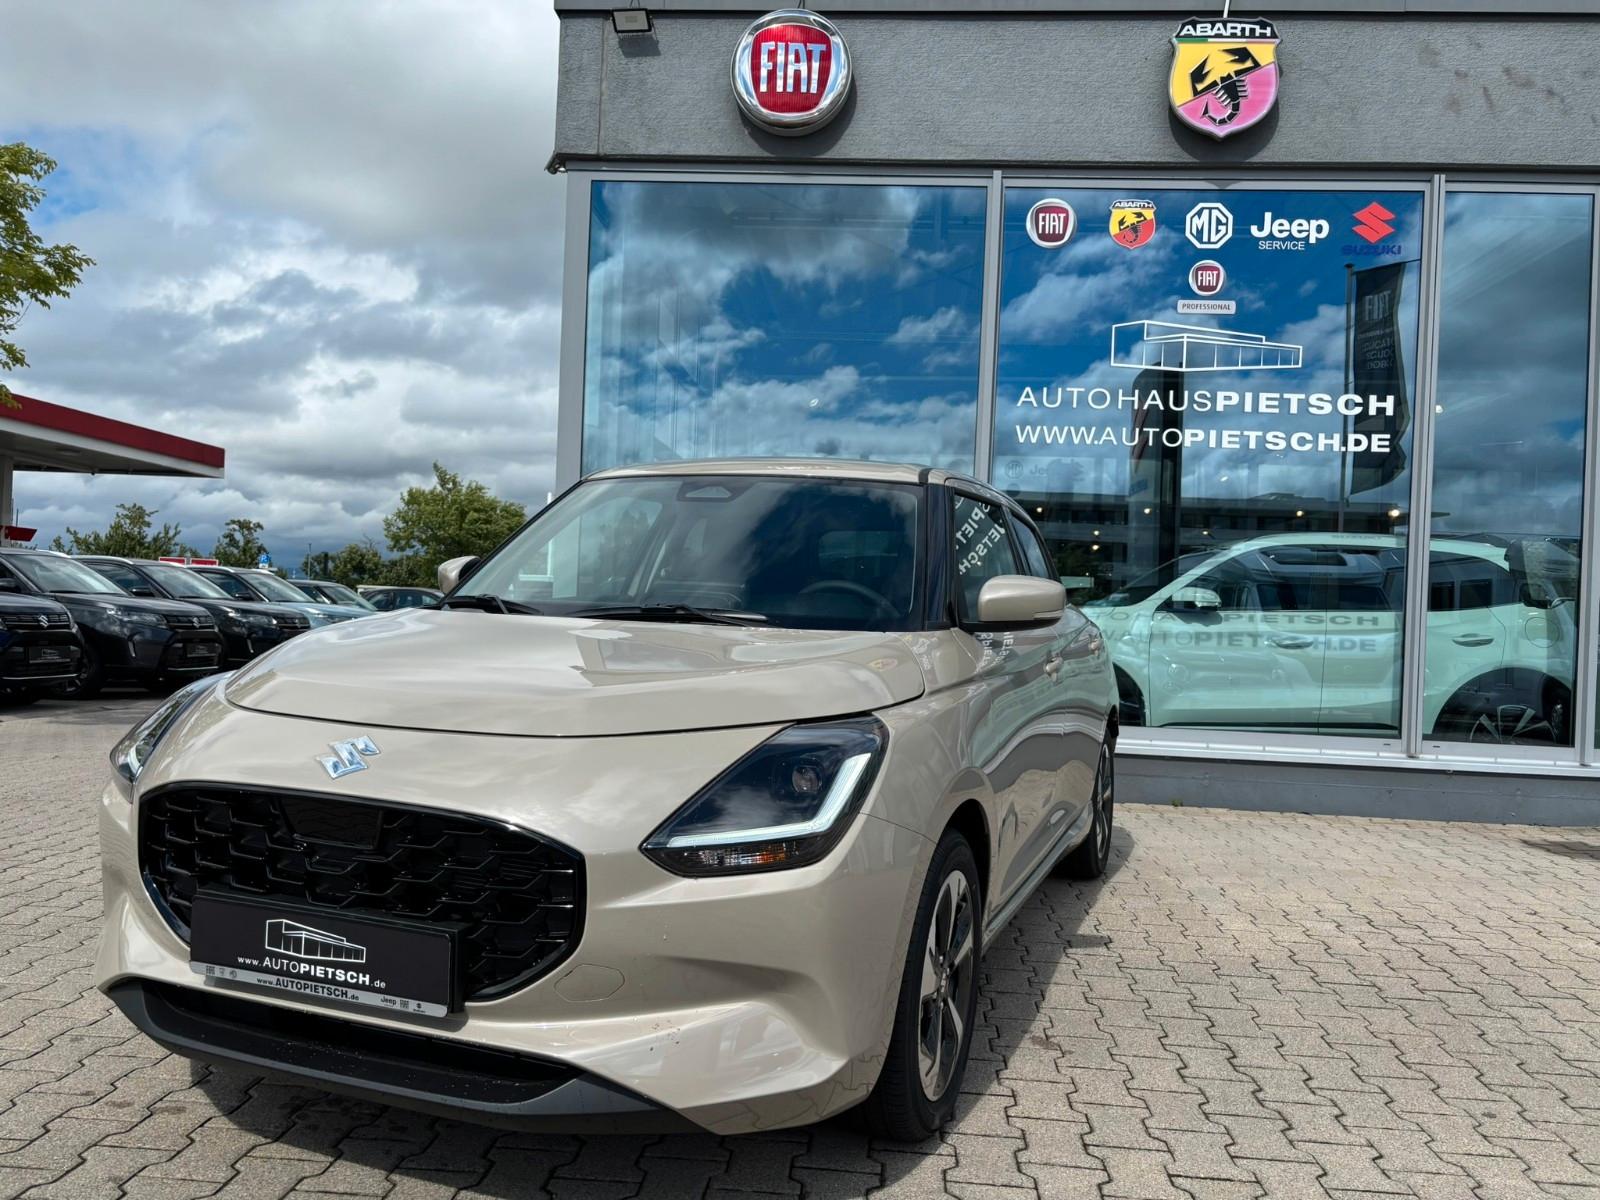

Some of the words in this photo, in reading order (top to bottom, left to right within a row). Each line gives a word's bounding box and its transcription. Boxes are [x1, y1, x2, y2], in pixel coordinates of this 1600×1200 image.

[1179, 23, 1271, 36] ABARTH
[760, 41, 827, 93] FIAT
[1038, 213, 1067, 235] FIAT
[1190, 208, 1227, 243] MG
[1250, 212, 1330, 244] Jeep
[1258, 240, 1306, 250] SERVICE
[1342, 245, 1402, 256] SUZUKI
[1197, 270, 1219, 287] FIAT
[1182, 302, 1231, 311] PROFESSIONAL
[1015, 424, 1391, 454] WWW.AUTOPIETSCH.DE
[237, 955, 387, 989] www.AUTOPIETSCH.de
[256, 977, 360, 1001] www.AUTOPIETSCH.de
